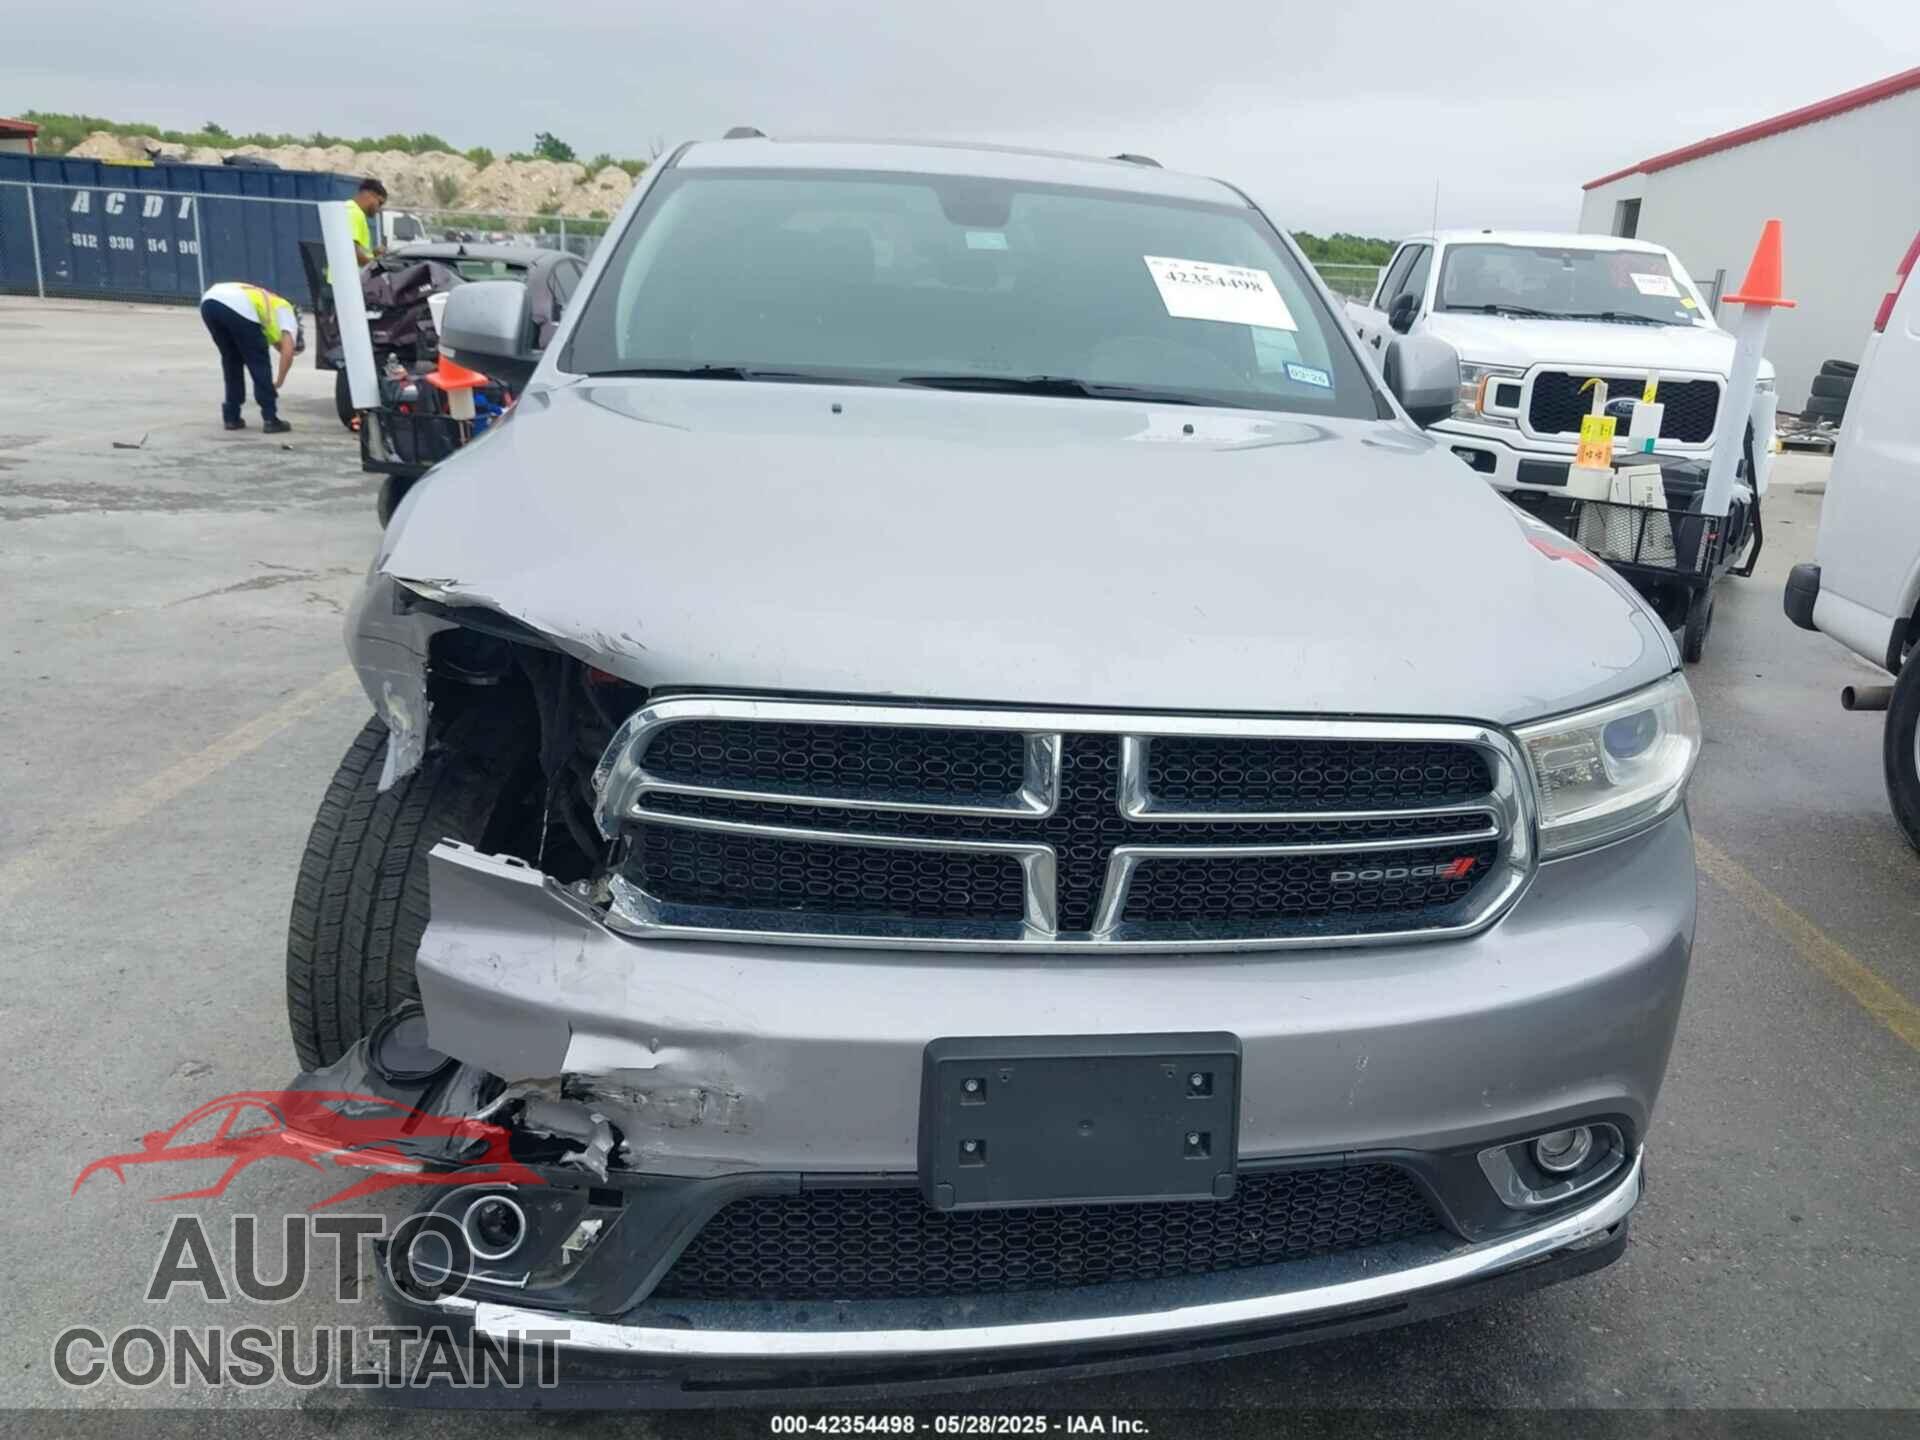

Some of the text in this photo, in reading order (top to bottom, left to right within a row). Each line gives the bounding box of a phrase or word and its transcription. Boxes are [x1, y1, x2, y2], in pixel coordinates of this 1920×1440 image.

[72, 232, 98, 249] 512
[1165, 271, 1264, 293] 42354498
[1330, 863, 1457, 882] DODGE
